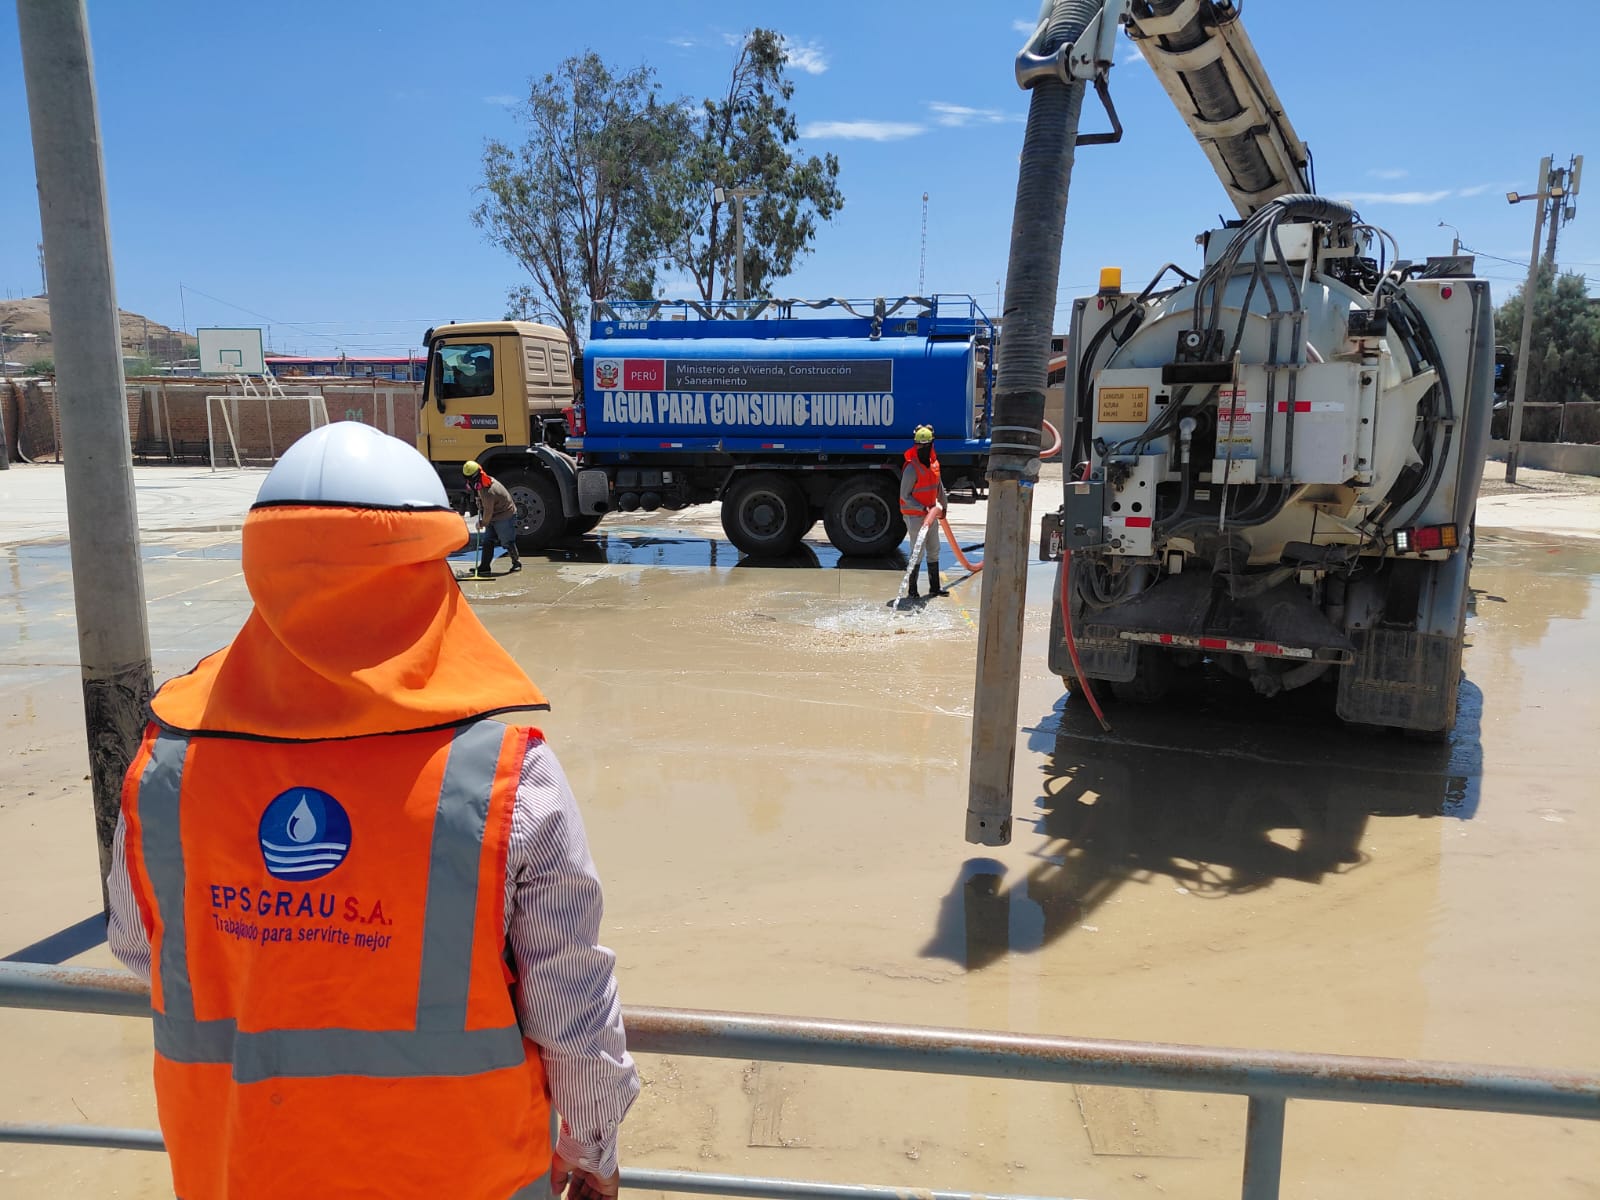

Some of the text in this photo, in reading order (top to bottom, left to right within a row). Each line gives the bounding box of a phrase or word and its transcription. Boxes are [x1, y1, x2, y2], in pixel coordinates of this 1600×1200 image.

[631, 369, 657, 381] PERÚ
[676, 364, 852, 376] Ministerio de Vivienda, Construcción
[676, 376, 747, 386] y Saneamiento
[603, 391, 894, 427] AGUA PARA CONSUMO HUMANO
[210, 884, 393, 926] EPS GRAU S.A.
[261, 925, 293, 946] para
[297, 925, 350, 945] servirte
[354, 931, 392, 952] mejor
